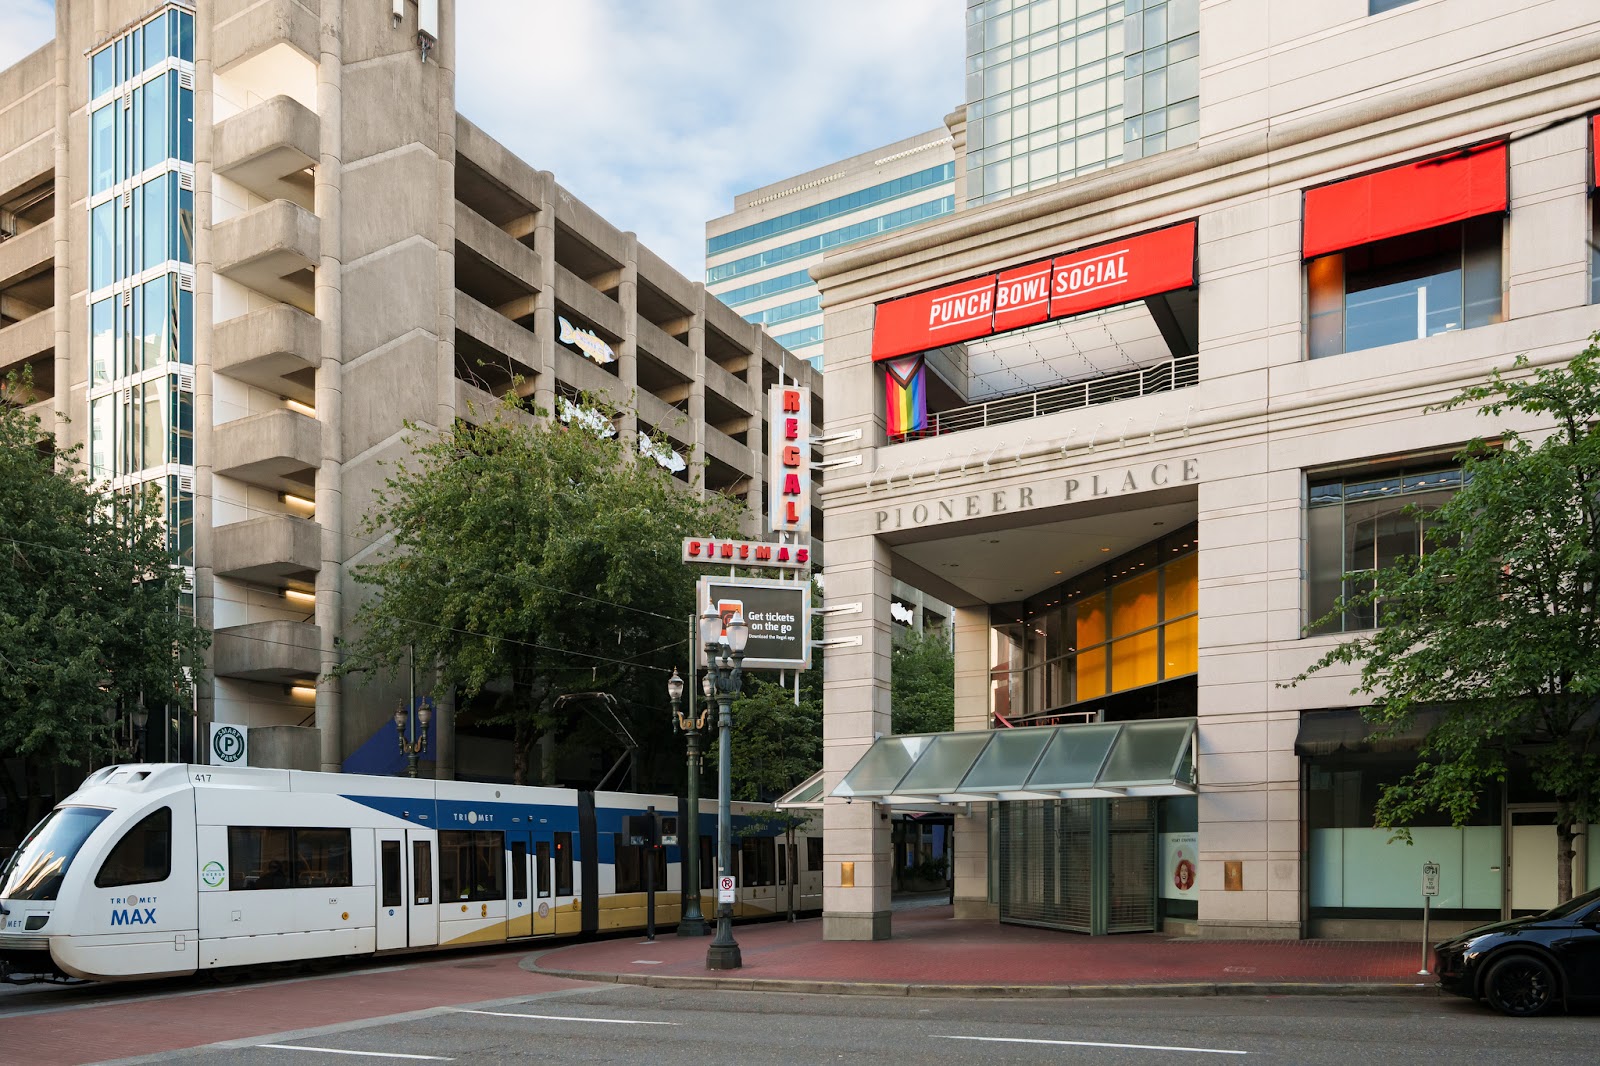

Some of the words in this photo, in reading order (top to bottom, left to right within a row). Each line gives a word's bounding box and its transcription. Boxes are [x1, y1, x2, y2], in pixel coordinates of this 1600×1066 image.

[929, 290, 991, 325] PUNCH
[996, 277, 1049, 307] BOWL
[1056, 256, 1129, 293] SOCIAL
[783, 390, 801, 524] REGAL
[875, 486, 1034, 531] PIONEER
[1063, 458, 1200, 501] PLACE
[688, 541, 809, 563] CINEMAS
[748, 611, 764, 621] Get
[765, 612, 795, 622] tickets
[764, 622, 779, 631] the
[780, 624, 792, 634] go
[217, 728, 241, 738] SMART
[224, 736, 235, 752] P
[220, 753, 239, 762] PARK
[195, 774, 212, 782] 417
[110, 908, 157, 926] MAX
